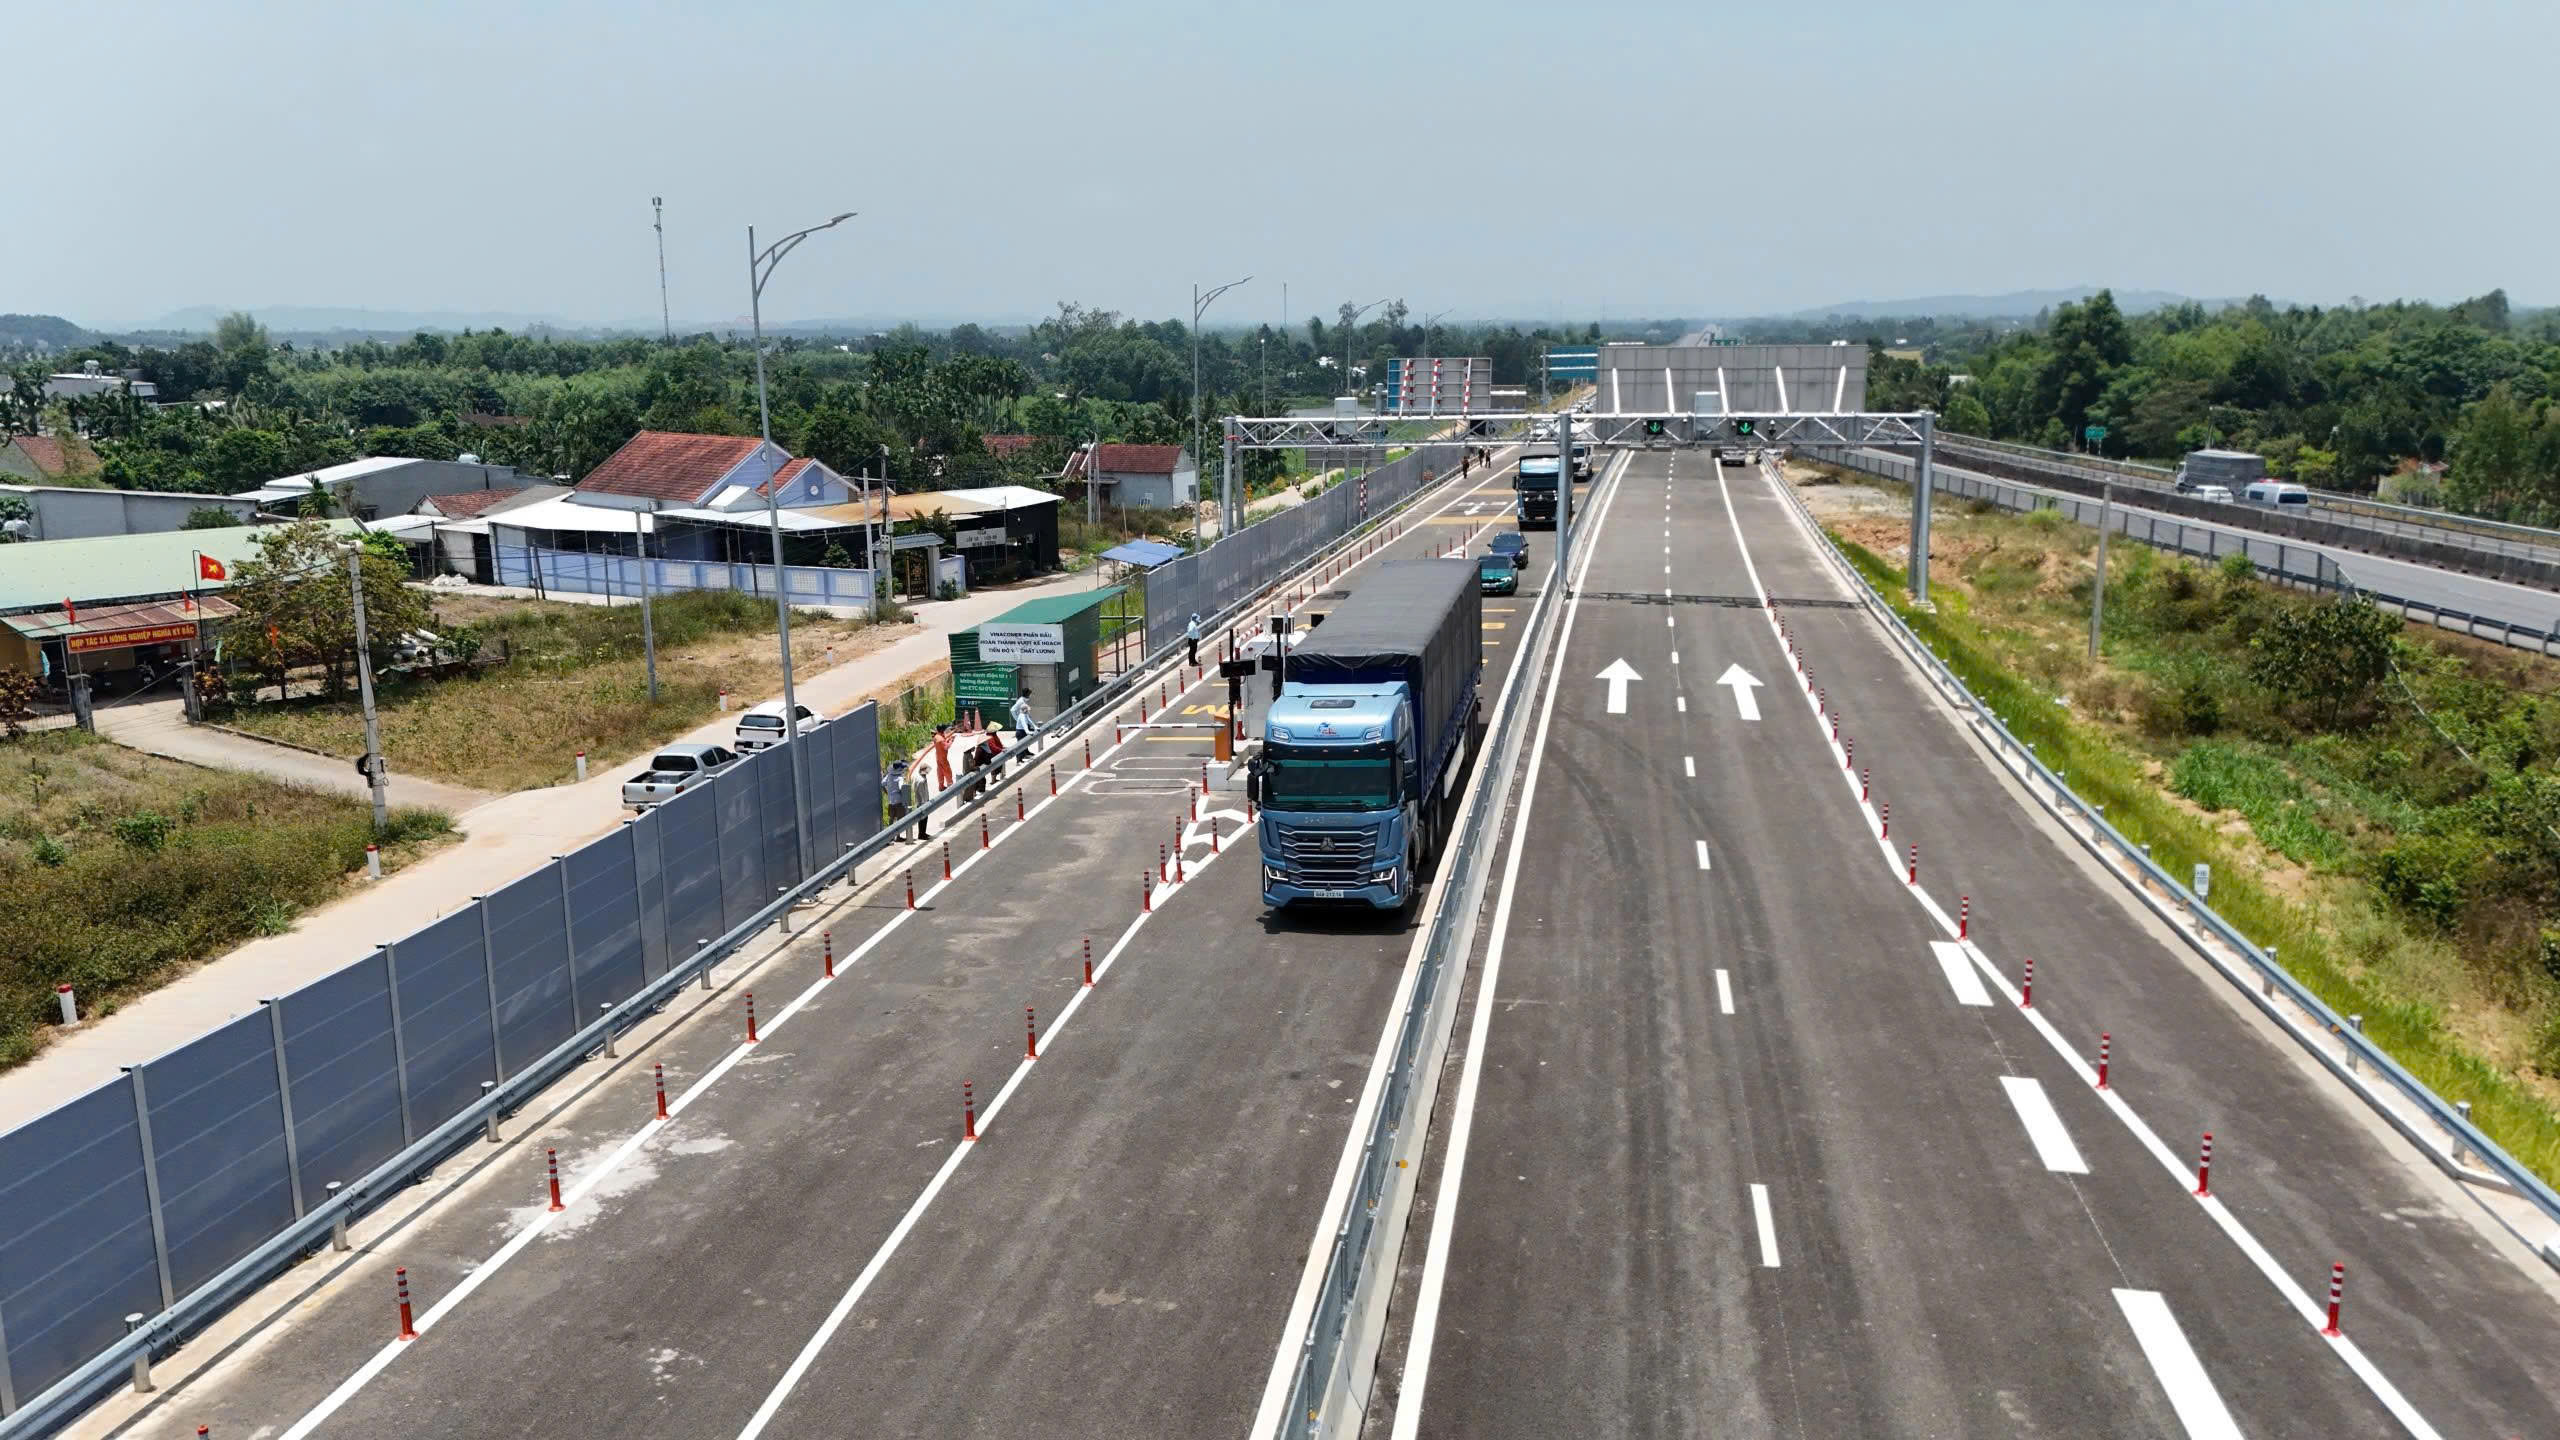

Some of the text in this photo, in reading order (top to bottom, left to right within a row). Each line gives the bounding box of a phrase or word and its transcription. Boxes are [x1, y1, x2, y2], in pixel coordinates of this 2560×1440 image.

[85, 637, 98, 645] TÁC
[99, 635, 109, 644] XÃ
[109, 634, 127, 643] NÔNG
[128, 631, 151, 641] NGHIỆP
